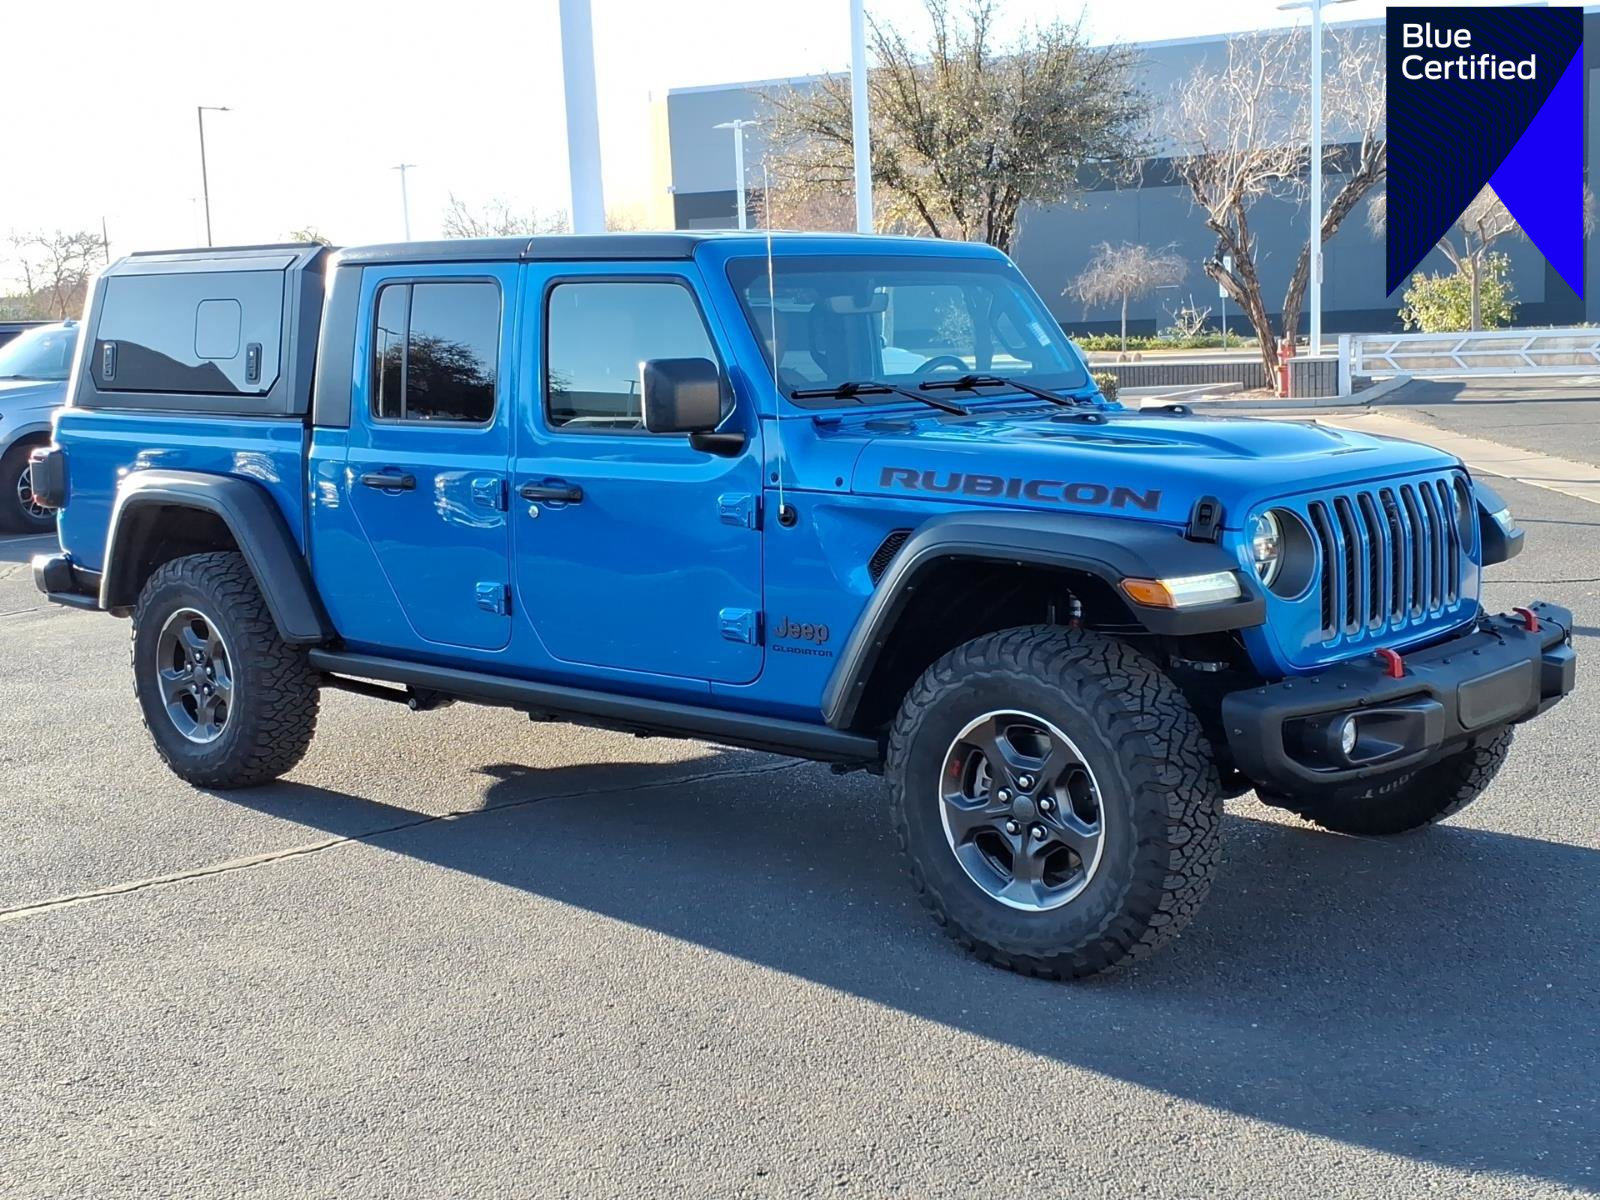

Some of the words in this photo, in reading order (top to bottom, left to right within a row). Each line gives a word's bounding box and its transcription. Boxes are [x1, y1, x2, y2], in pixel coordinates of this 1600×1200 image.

[879, 466, 1162, 512] RUBICON
[775, 615, 829, 646] Jeep
[772, 644, 833, 657] GLADIATOR
